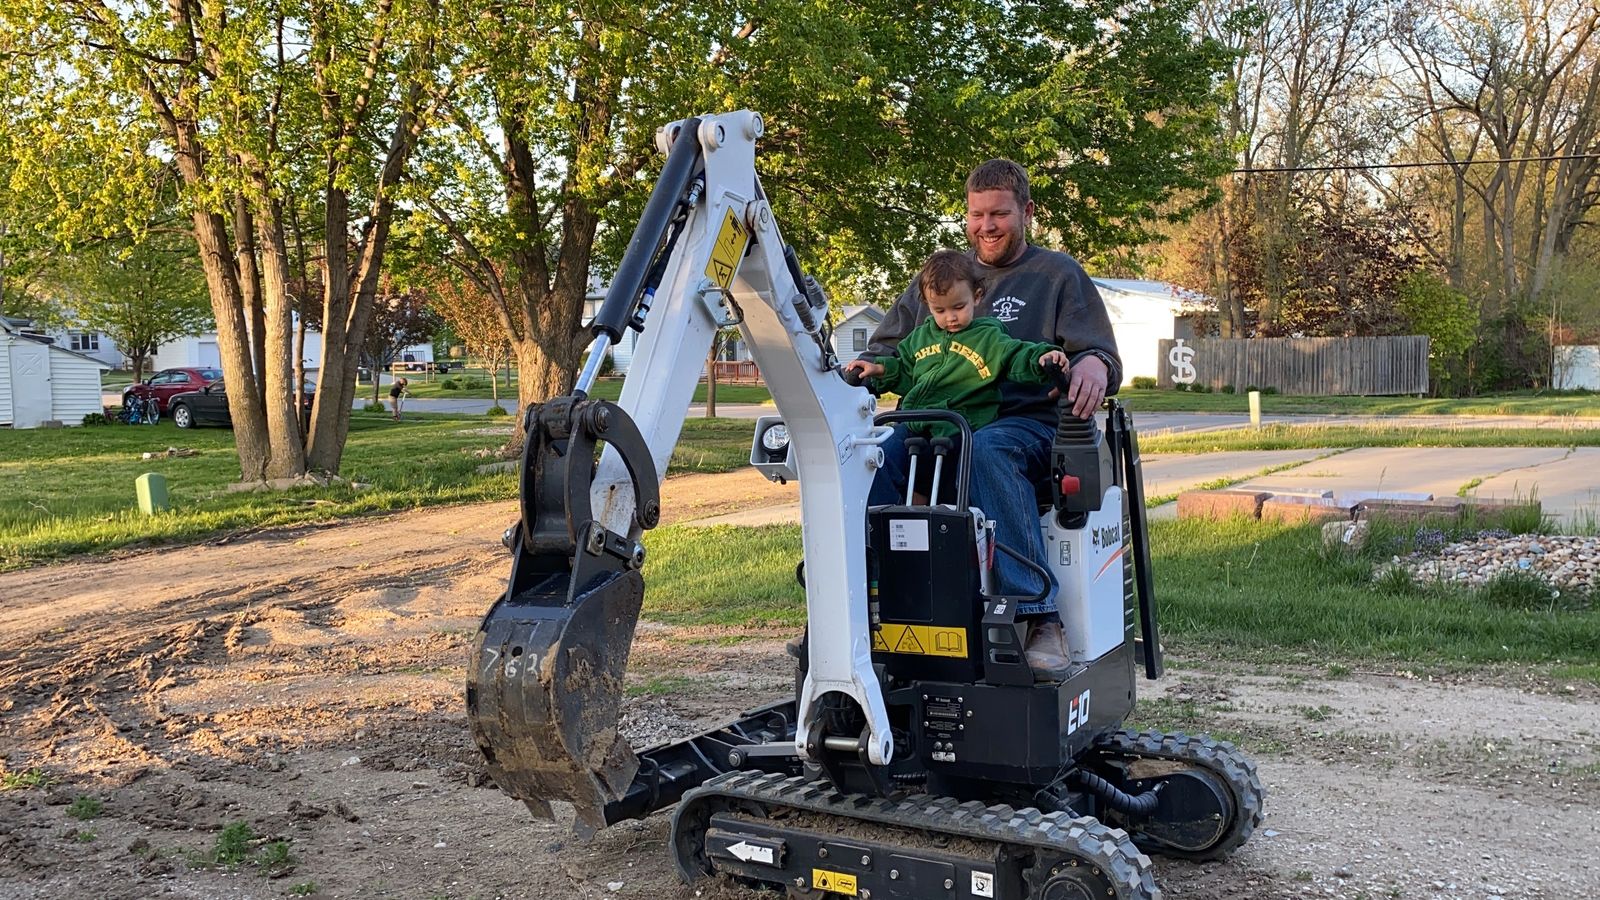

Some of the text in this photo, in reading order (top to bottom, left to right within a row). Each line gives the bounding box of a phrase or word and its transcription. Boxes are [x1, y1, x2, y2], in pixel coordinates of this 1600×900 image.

[914, 341, 991, 379] OHN DEERE
[1101, 522, 1120, 549] Bobcat
